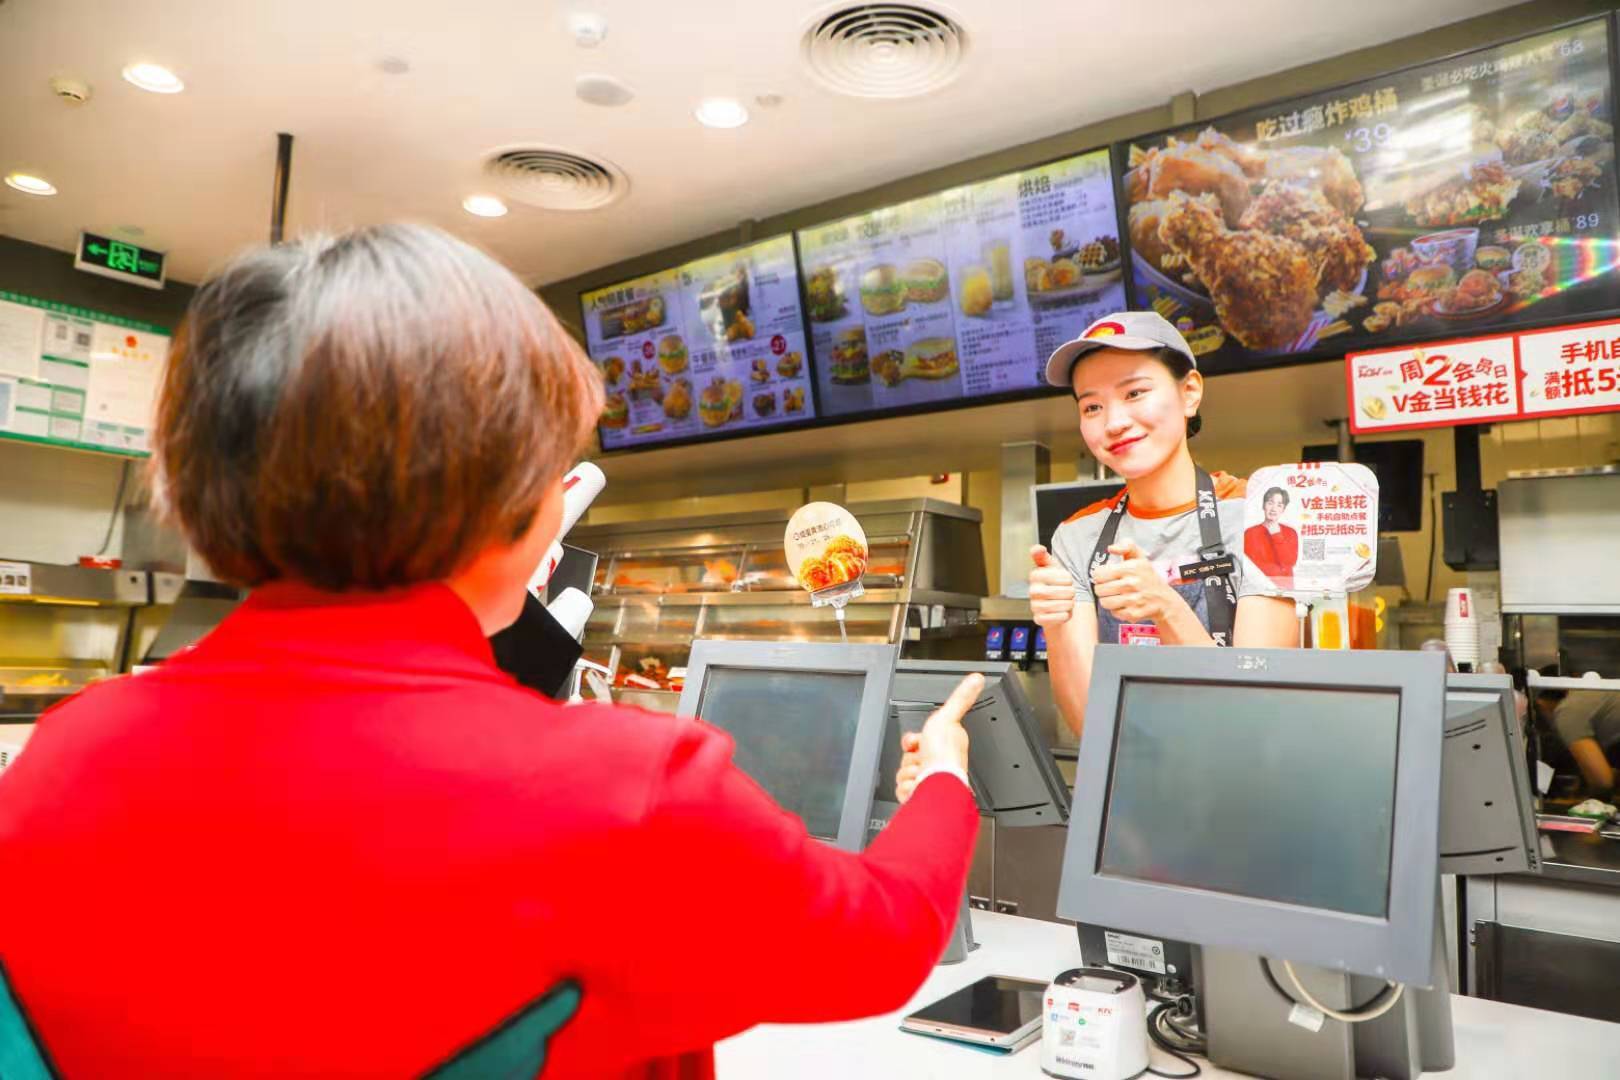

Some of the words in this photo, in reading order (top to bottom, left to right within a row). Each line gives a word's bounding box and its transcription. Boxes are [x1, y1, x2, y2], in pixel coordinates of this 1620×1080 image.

[1256, 87, 1398, 141] 吃过瘾炸鸡桶
[1576, 213, 1599, 229] 89
[1400, 355, 1508, 385] 周2会员日
[1562, 367, 1620, 397] 抵5
[1392, 381, 1510, 413] V金当钱花
[1198, 490, 1216, 519] KFC
[1301, 495, 1367, 509] V金当钱花
